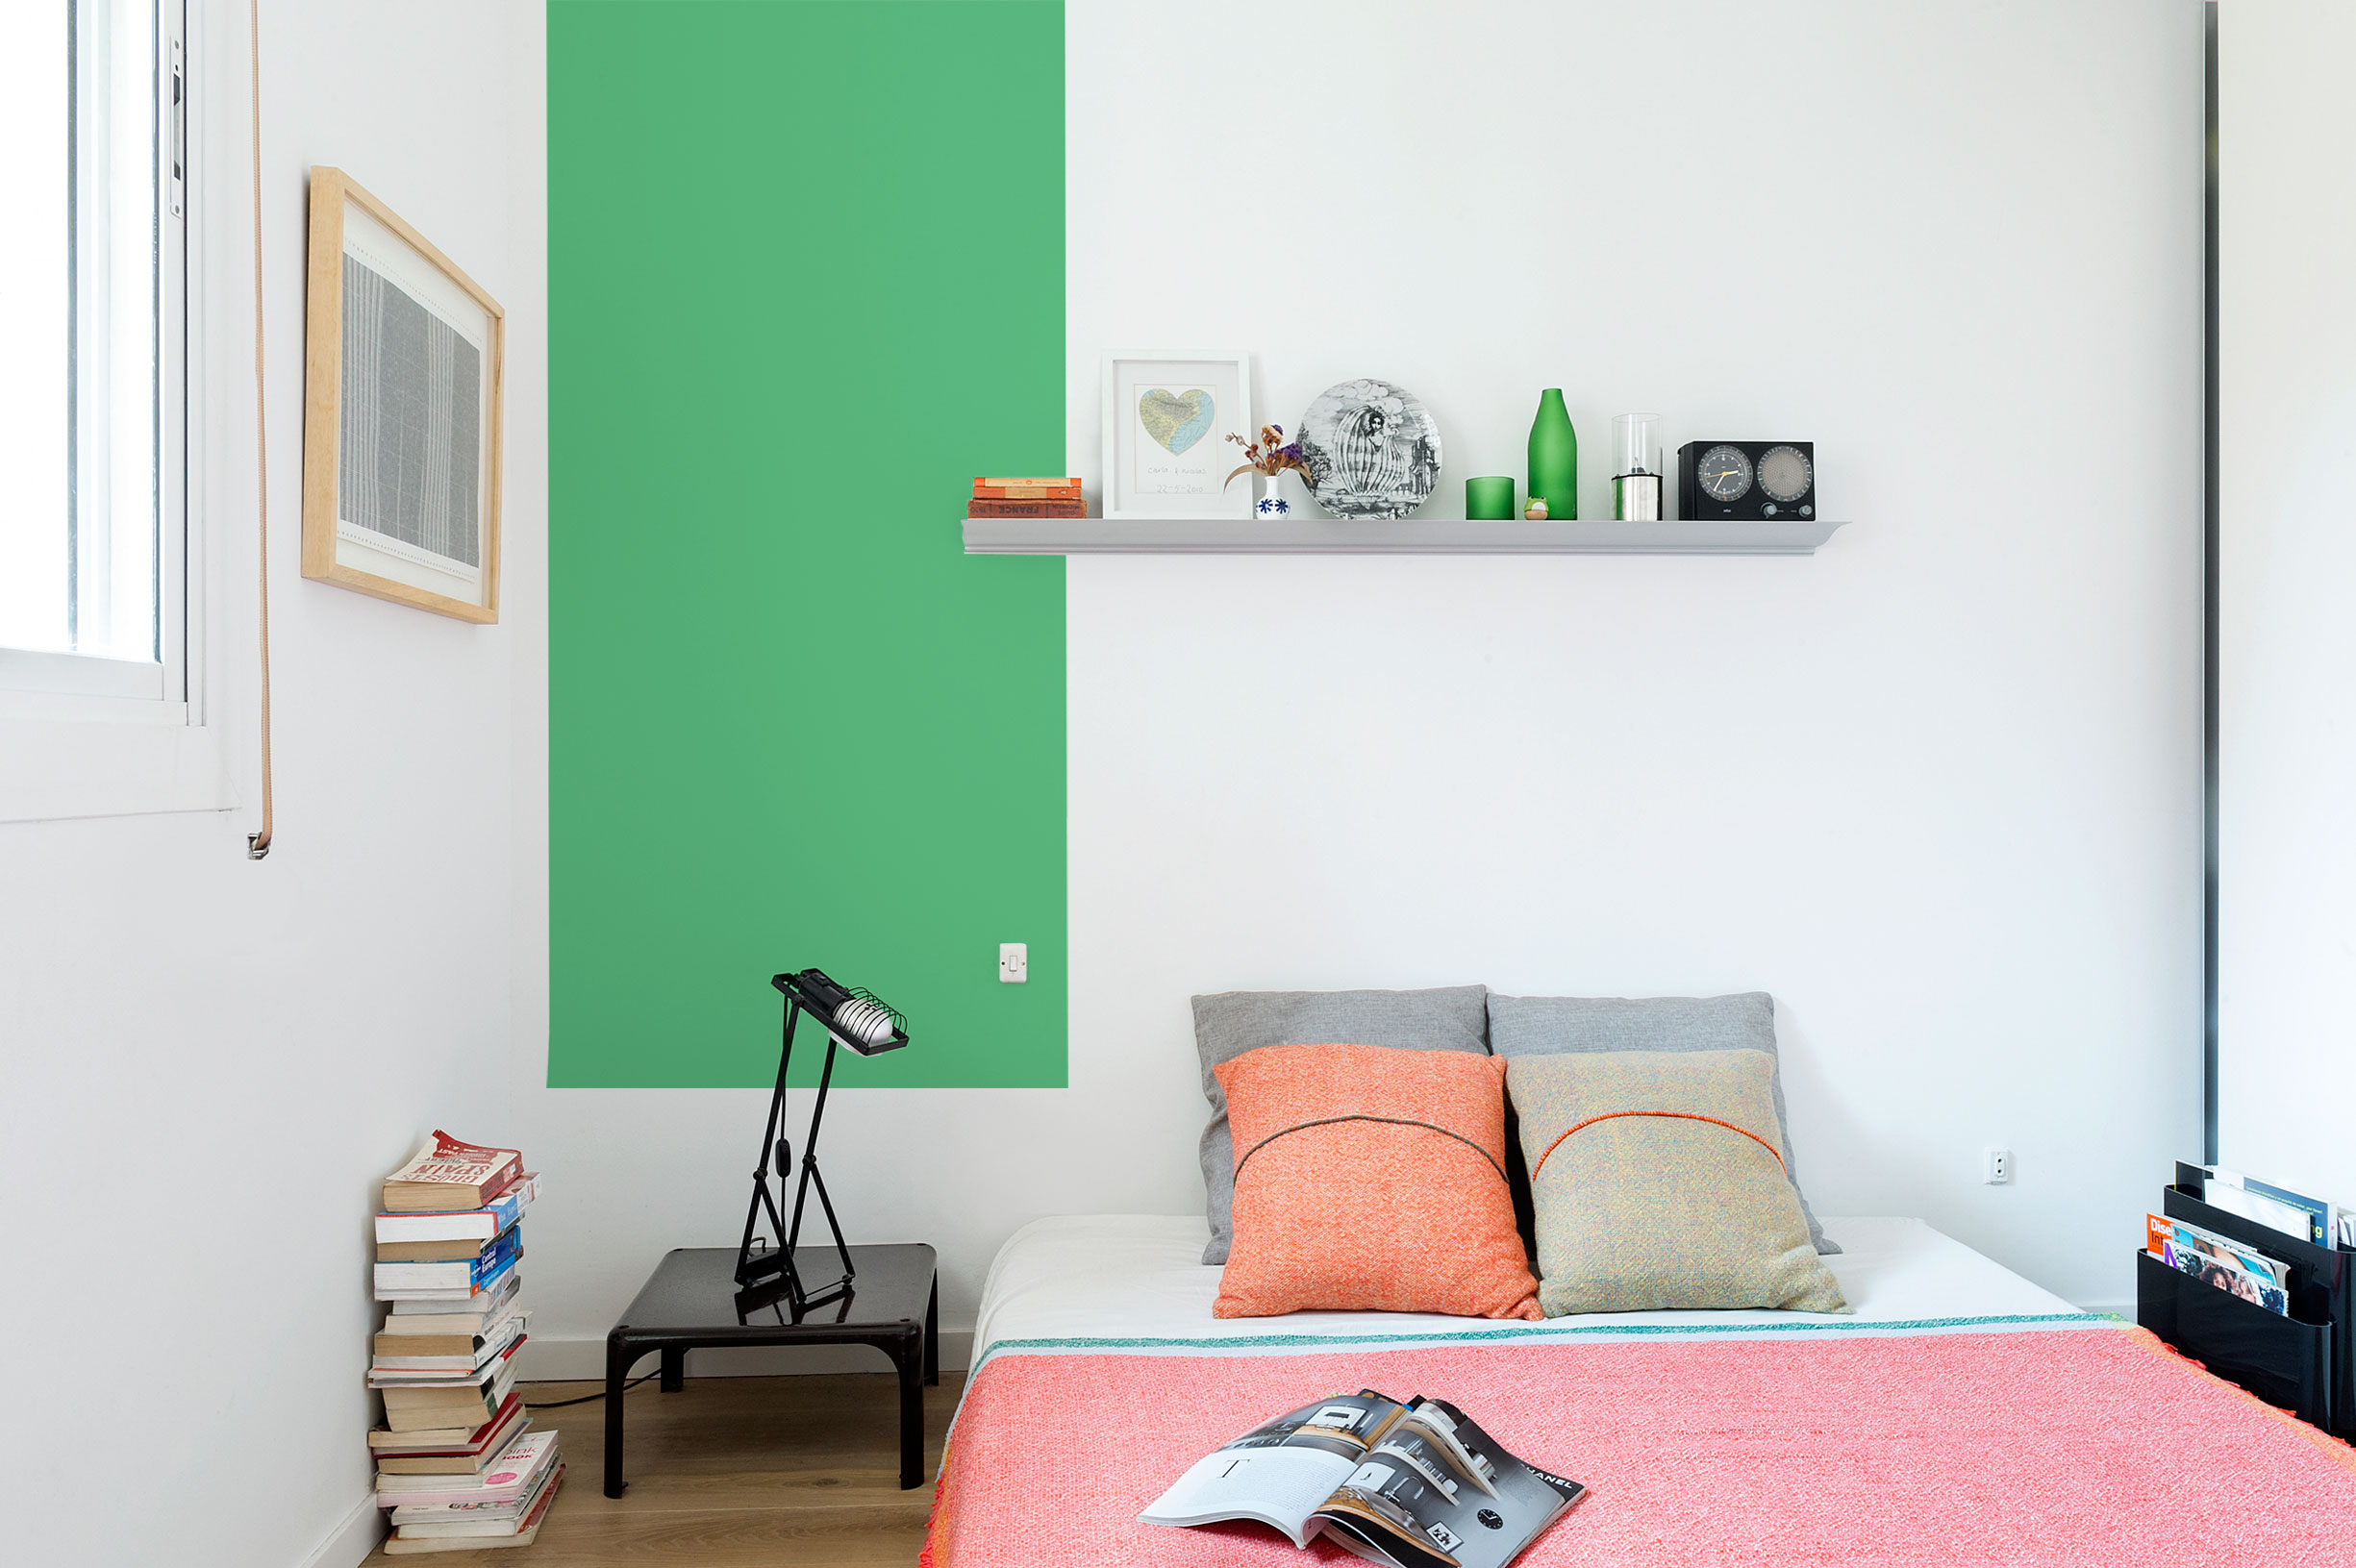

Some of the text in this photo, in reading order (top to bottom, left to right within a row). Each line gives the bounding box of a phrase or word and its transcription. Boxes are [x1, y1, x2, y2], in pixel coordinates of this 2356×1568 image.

[998, 506, 1040, 514] FRANCE
[413, 1164, 490, 1175] SPAIN
[2150, 1218, 2172, 1236] Dise
[481, 1257, 496, 1274] Europe
[1519, 1463, 1572, 1489] HANEL
